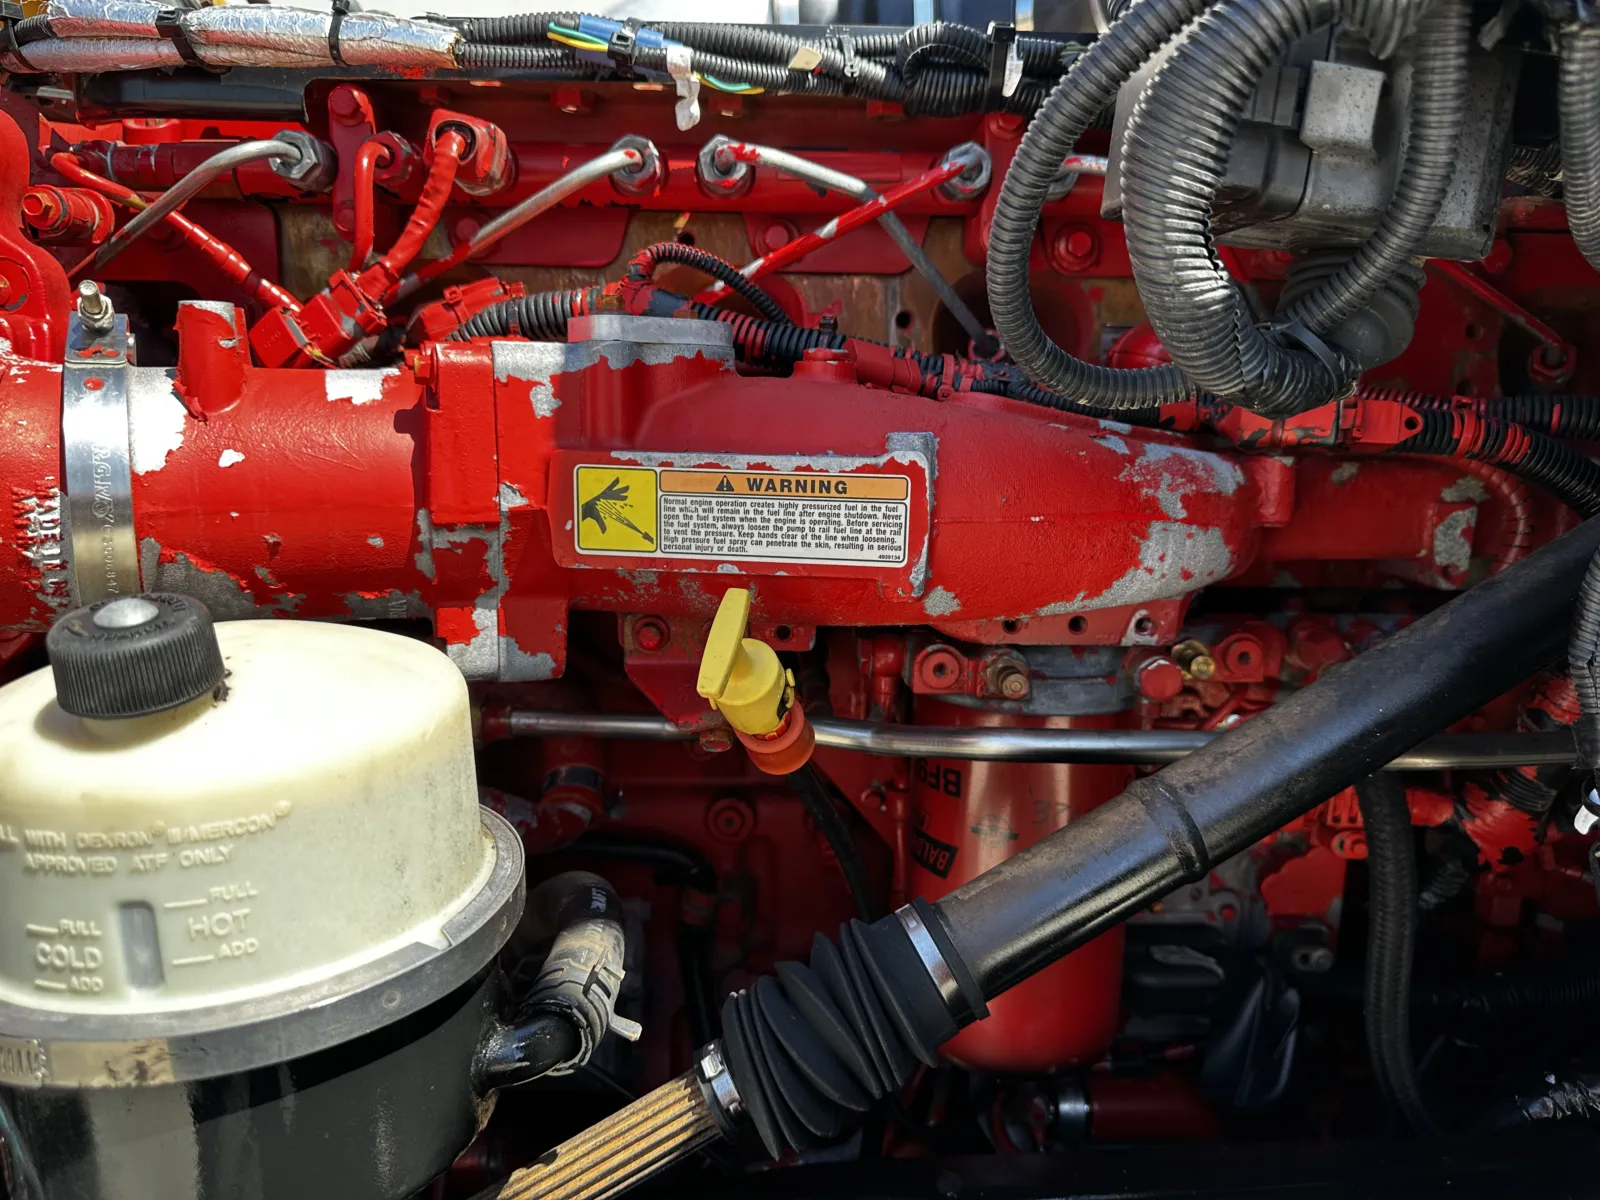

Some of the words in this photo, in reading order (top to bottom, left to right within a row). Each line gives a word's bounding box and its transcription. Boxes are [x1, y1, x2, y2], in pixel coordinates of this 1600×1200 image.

[747, 477, 848, 494] WARNING
[663, 497, 687, 505] Normal
[690, 498, 713, 508] engine
[715, 498, 747, 509] operation
[750, 500, 775, 508] creates
[778, 501, 799, 511] highly
[802, 501, 842, 512] pressurized
[845, 503, 858, 511] fuel
[861, 503, 868, 511] in
[871, 504, 882, 512] the
[885, 504, 898, 512] fuel
[663, 504, 676, 512] line
[702, 506, 714, 514] will
[717, 506, 740, 515] remain
[743, 507, 750, 515] in
[753, 507, 764, 515] the
[767, 508, 780, 516] fuel
[783, 508, 796, 516] line
[799, 509, 815, 517] after
[818, 509, 841, 520] engine
[844, 510, 879, 519] shutdown.
[882, 512, 902, 520] Never
[663, 513, 680, 522] open
[682, 512, 694, 520] the
[696, 513, 709, 521] fuel
[712, 513, 736, 524] system
[739, 514, 757, 523] when
[760, 515, 771, 523] the
[774, 515, 797, 526] engine
[800, 516, 806, 524] is
[809, 517, 843, 527] operating.
[846, 518, 869, 526] Before
[872, 519, 903, 529] servicing
[663, 519, 674, 527] the
[677, 520, 690, 528] fuel
[693, 520, 719, 531] system,
[721, 521, 745, 532] always
[748, 522, 770, 531] loosen
[773, 523, 784, 531] the
[787, 525, 806, 534] pump
[809, 524, 816, 532] to
[819, 524, 830, 533] rail
[833, 525, 847, 533] fuel
[850, 526, 862, 534] line
[865, 526, 873, 534] at
[876, 526, 887, 534] the
[890, 527, 902, 535] rail
[664, 527, 670, 535] to
[673, 527, 688, 535] vent
[691, 528, 701, 536] the
[704, 530, 735, 539] pressure.
[738, 529, 755, 539] Keep
[758, 530, 778, 538] hands
[781, 531, 798, 539] clear
[801, 531, 808, 539] of
[811, 532, 822, 540] the
[825, 532, 838, 540] line
[841, 533, 859, 541] when
[862, 534, 896, 544] loosening.
[664, 534, 679, 544] High
[681, 537, 710, 546] pressure
[713, 536, 726, 544] fuel
[729, 538, 748, 547] spray
[766, 538, 798, 548] penetrate
[801, 539, 812, 547] the
[815, 540, 831, 549] skin,
[834, 540, 864, 551] resulting
[867, 541, 874, 549] in
[877, 542, 902, 550] serious
[663, 542, 692, 552] personal
[695, 543, 714, 553] injury
[727, 544, 748, 552] death.
[25, 828, 67, 848] WITH
[26, 852, 118, 873] APPROVED
[132, 852, 168, 871] ATF
[180, 843, 234, 867] ONLY
[209, 880, 259, 901] FULL
[59, 918, 102, 935] FULL
[188, 907, 251, 938] HOT
[36, 941, 102, 969] COLD
[219, 937, 260, 958] ADD
[70, 975, 104, 991] ADD
